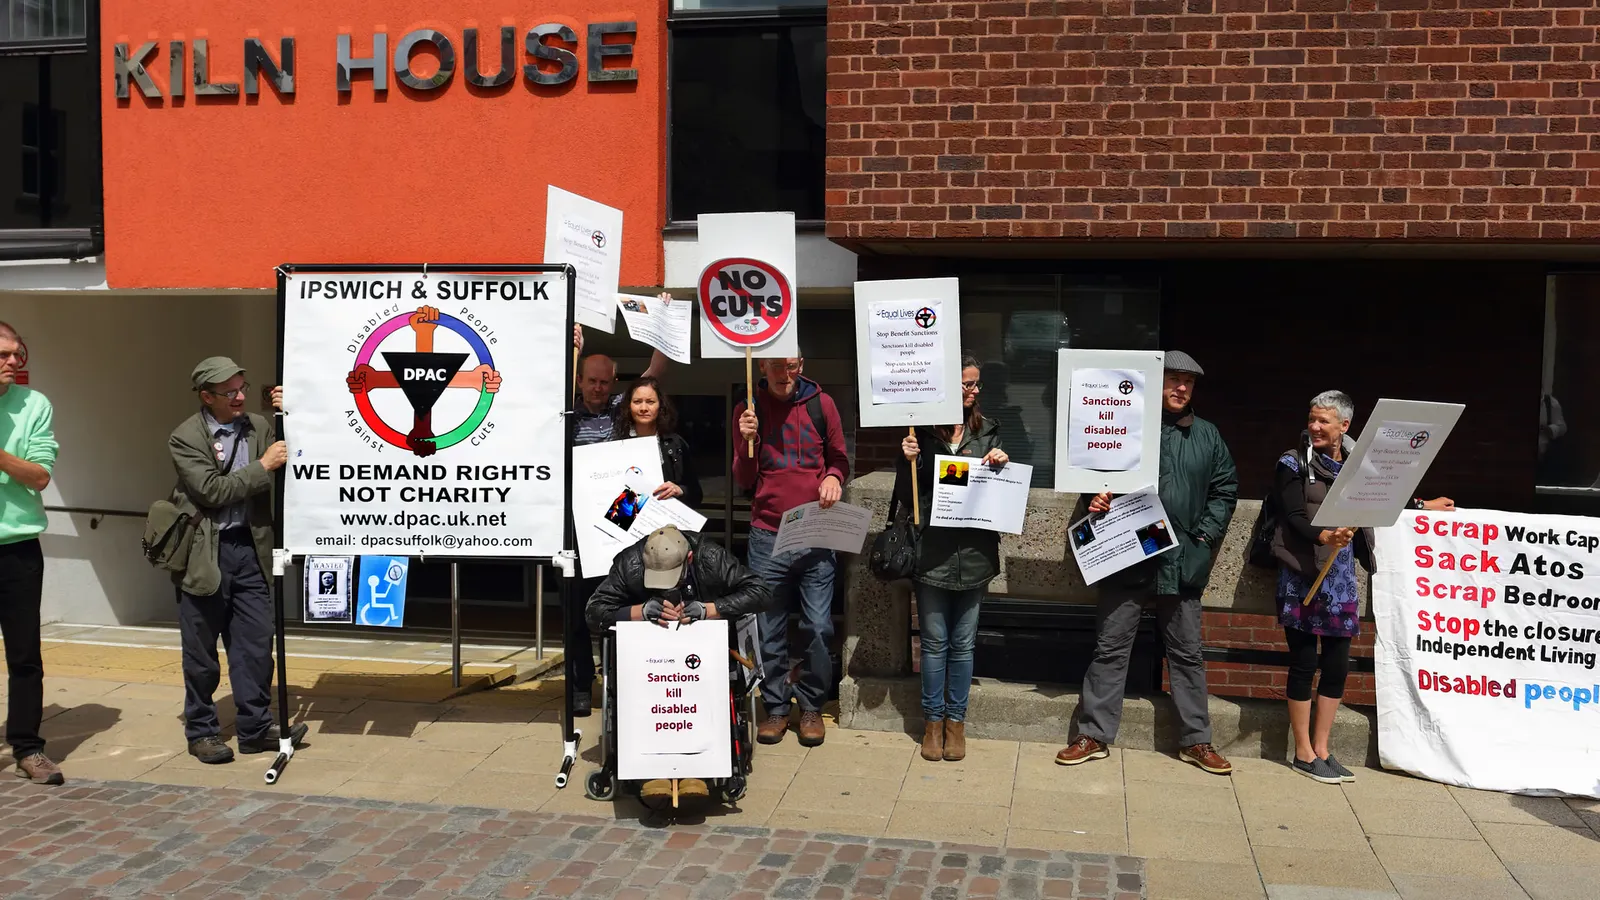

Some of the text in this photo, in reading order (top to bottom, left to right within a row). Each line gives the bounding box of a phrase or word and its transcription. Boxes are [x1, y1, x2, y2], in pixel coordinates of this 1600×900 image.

[114, 21, 639, 99] KILN HOUSE
[718, 270, 767, 290] NO
[300, 280, 550, 300] IPSWICH & SUFFOLK
[710, 295, 783, 318] CUTS
[881, 309, 914, 318] Equal Lives
[347, 303, 498, 354] Disabled People
[877, 330, 889, 338] Stop
[403, 368, 447, 382] DPAC
[1082, 396, 1131, 406] Sanctions
[1098, 410, 1114, 420] kill
[344, 408, 496, 453] Against Cuts
[1084, 425, 1127, 435] disabled
[1087, 440, 1122, 451] people
[293, 464, 552, 481] WE DEMAND RIGHTS
[339, 487, 512, 503] NOT CHARITY
[340, 511, 507, 529] www.dpac.uk.net
[315, 534, 533, 549] email: dpacsuffolk@yahoo.com
[1413, 515, 1600, 553] Scrap Work Cap
[1414, 545, 1584, 579] Sack Atos
[1416, 577, 1496, 608] Scrap
[1417, 610, 1480, 641] Stop
[1483, 619, 1518, 638] the
[1416, 634, 1597, 669] Independent Living
[647, 672, 699, 682] Sanctions
[666, 688, 682, 698] kill
[1418, 669, 1600, 711] Disabled peopl
[651, 704, 697, 714] disabled
[655, 720, 693, 732] people
